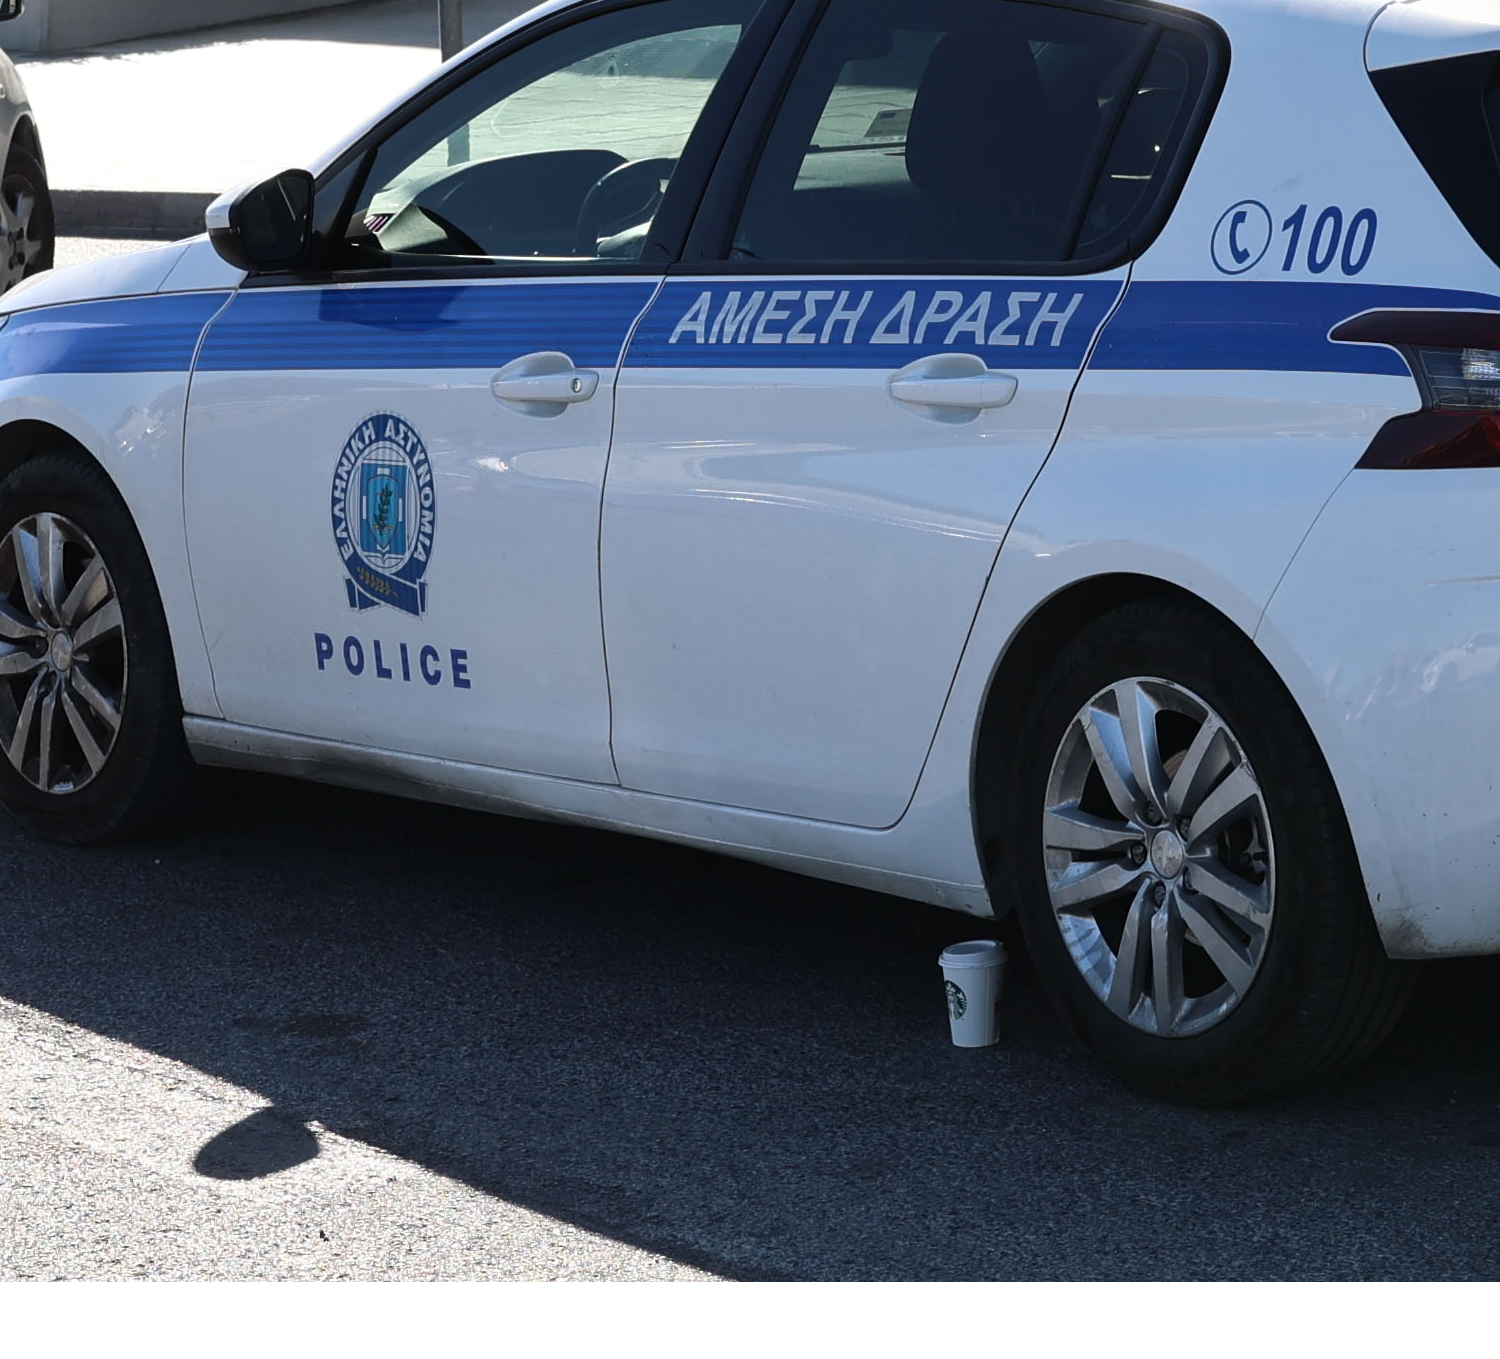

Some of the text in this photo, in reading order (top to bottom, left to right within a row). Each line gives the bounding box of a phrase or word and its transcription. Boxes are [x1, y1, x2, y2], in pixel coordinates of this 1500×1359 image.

[1278, 204, 1378, 276] 100
[669, 287, 1084, 348] ΑΜΕΣΗ ΔΡΑΣΗ
[332, 418, 434, 563] ΕΛΛΗΝΙΚΗ ΑΣΤΥΝΟΜΙΑ
[314, 632, 472, 689] POLICE
